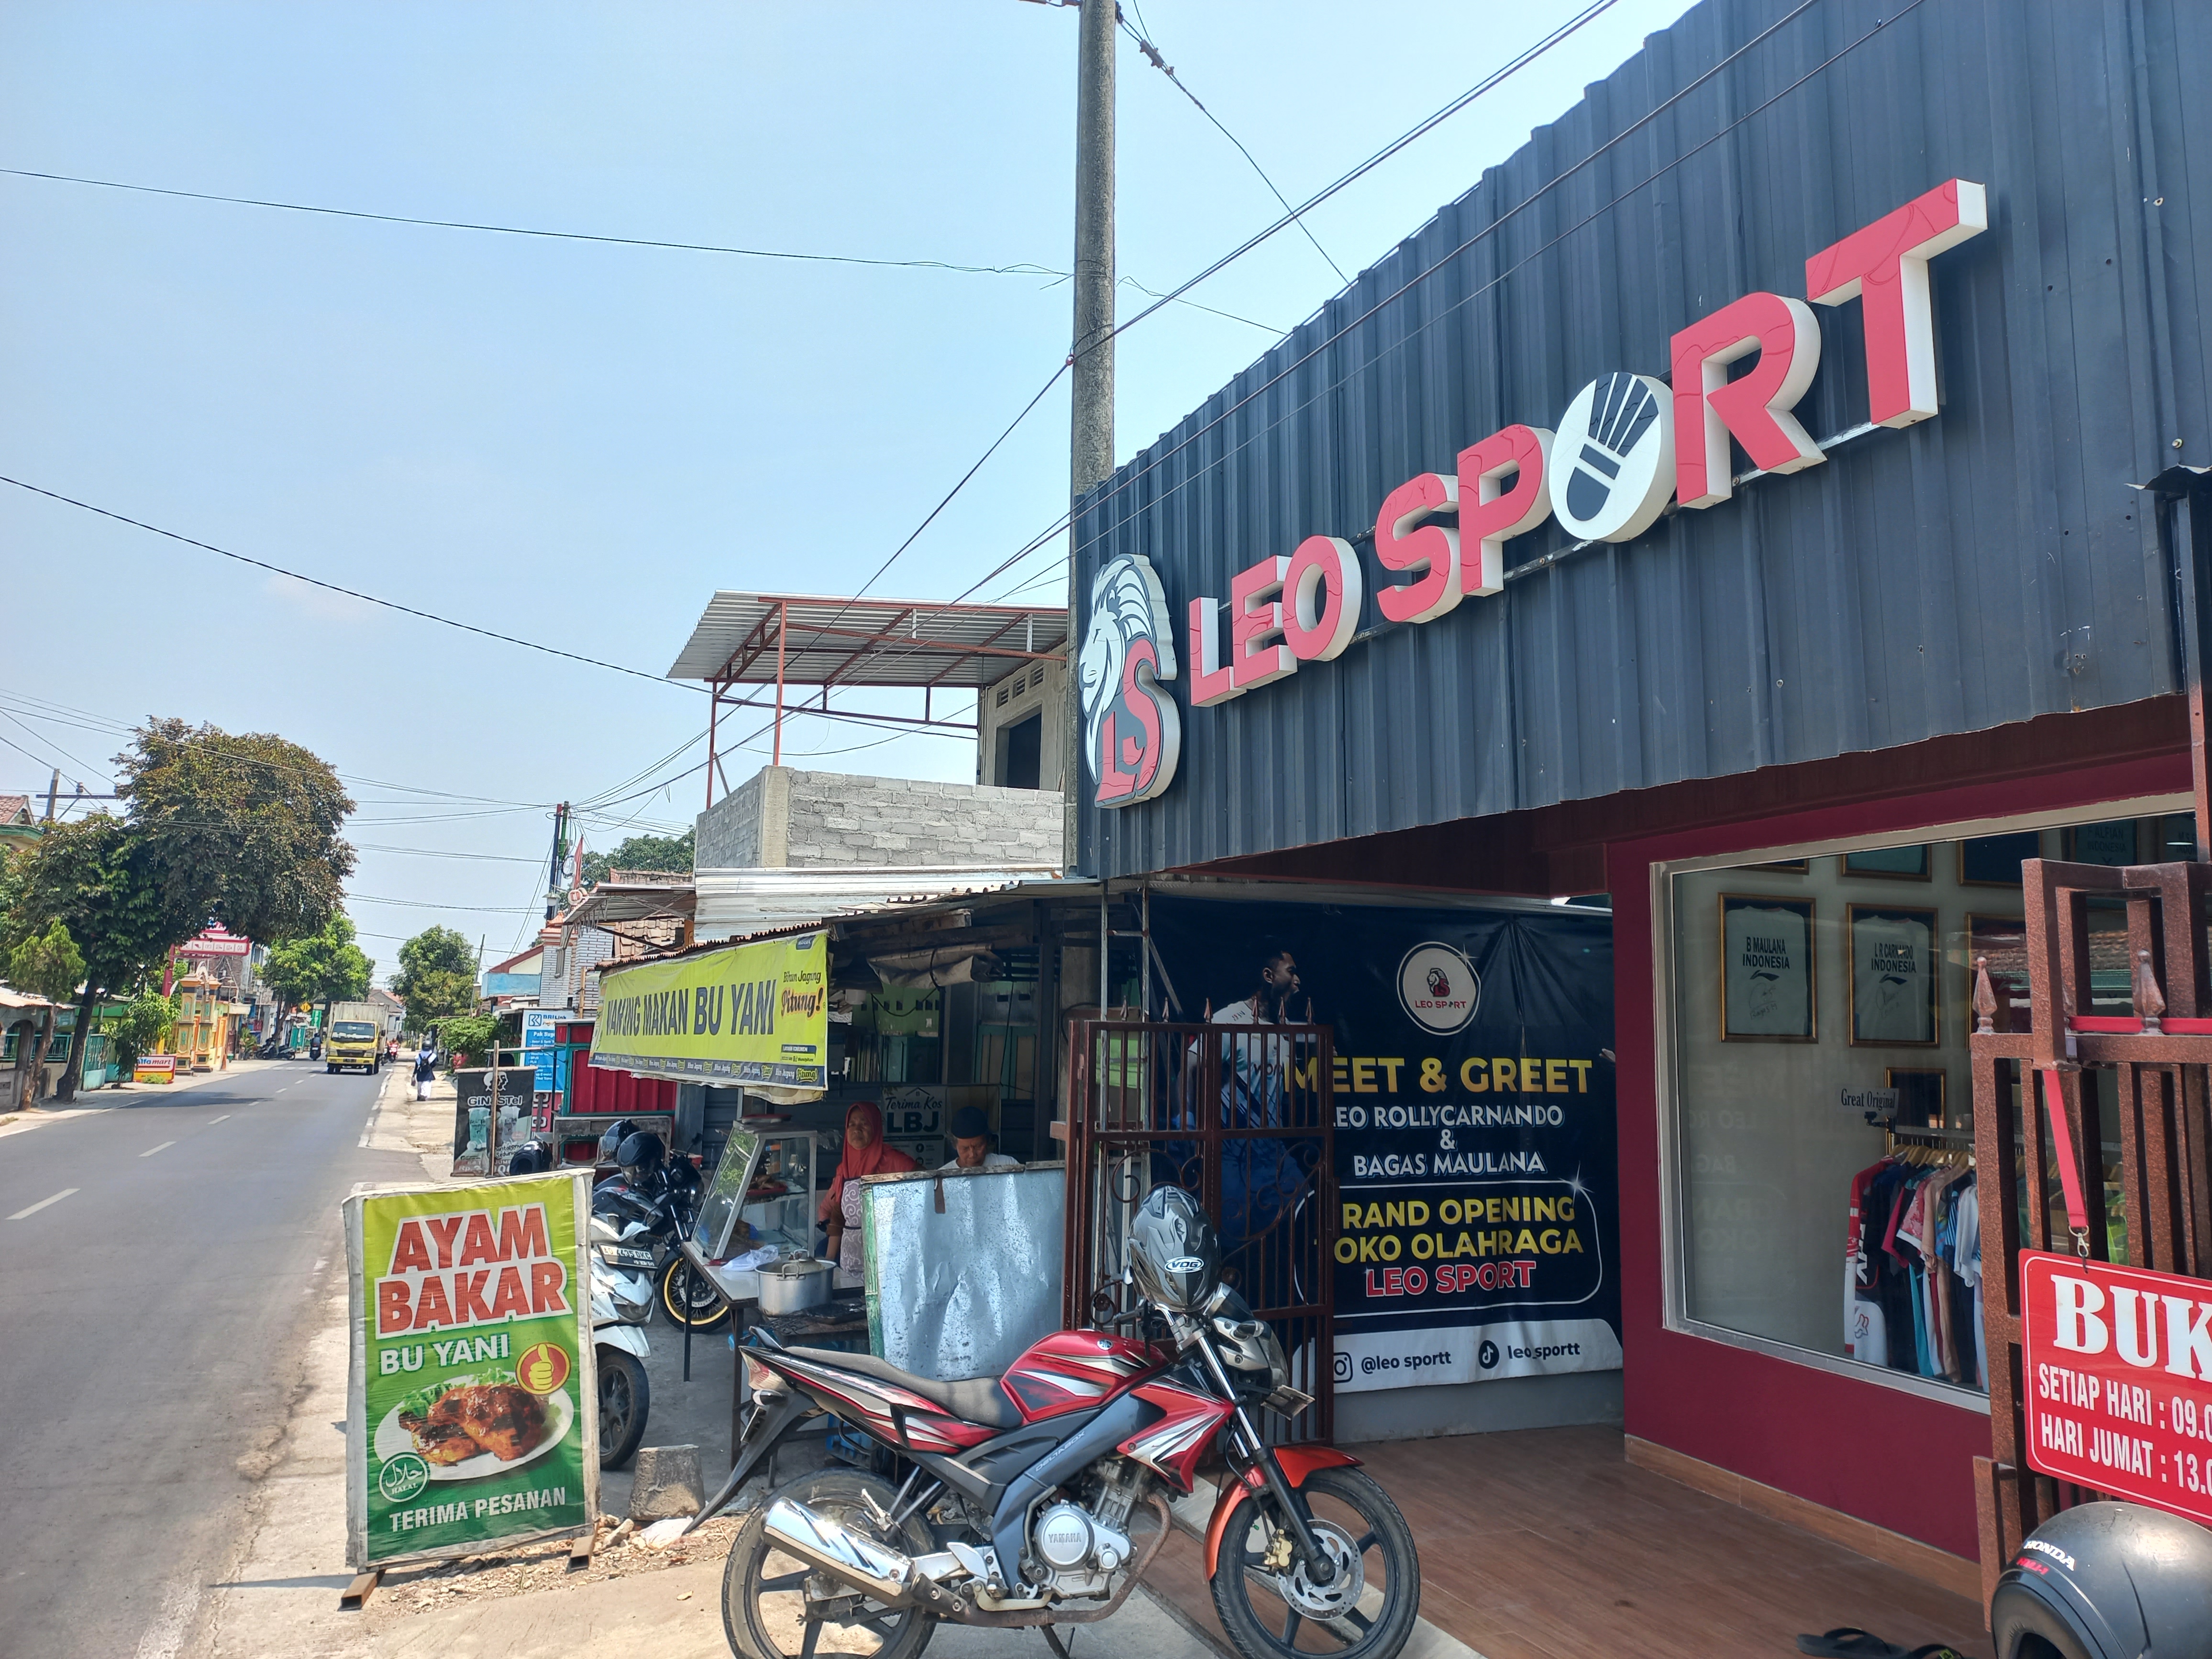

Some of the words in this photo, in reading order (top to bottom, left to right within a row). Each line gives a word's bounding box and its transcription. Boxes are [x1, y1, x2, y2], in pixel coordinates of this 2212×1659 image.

[1189, 535, 1360, 707] LEO
[1375, 178, 1988, 623] SPORT
[1746, 937, 1751, 952] B
[1753, 937, 1786, 954] MAULANA
[1879, 942, 1883, 958] R
[1742, 953, 1790, 969] INDONESIA
[1871, 958, 1917, 973] INDONESIA
[797, 970, 821, 984] Jagung
[693, 984, 724, 1035] BU
[730, 979, 777, 1035] YANI
[781, 987, 824, 1018] Pitung!
[1415, 1000, 1433, 1008] LEO
[1419, 1057, 1448, 1094] &
[1460, 1057, 1593, 1094] GREET
[885, 1096, 921, 1110] Terima
[923, 1096, 942, 1110] Kos
[1841, 1088, 1865, 1107] Great
[1867, 1091, 1896, 1111] Original
[886, 1111, 939, 1133] LBJ
[1333, 1106, 1368, 1128] EO
[1374, 1105, 1564, 1128] ROLLYCARNANDO
[1439, 1128, 1456, 1150] &
[1353, 1154, 1427, 1177] BAGAS
[1433, 1152, 1546, 1175] MAULANA
[1342, 1200, 1430, 1229] RAND
[1438, 1196, 1575, 1226] OPENING
[391, 1207, 548, 1275] AYAM
[1334, 1235, 1403, 1264] OKO
[1411, 1228, 1584, 1260] OLAHRAGA
[1366, 1266, 1429, 1298] LEO
[1435, 1260, 1536, 1294] SPORT
[379, 1261, 566, 1334] BAKAR
[2050, 1274, 2212, 1383] BUK
[380, 1344, 424, 1376] BU
[433, 1333, 509, 1367] YANI
[1361, 1355, 1400, 1374] @leo
[1404, 1351, 1452, 1370] sportt
[2038, 1362, 2101, 1411] SETIAP
[2106, 1379, 2153, 1426] HARI
[1035, 1430, 1085, 1472] DELTABOX
[2040, 1412, 2084, 1458] HARI
[2089, 1427, 2153, 1478] JUMAT
[386, 1462, 423, 1487] حلال
[391, 1482, 418, 1494] HALAL
[389, 1501, 468, 1532] TERIMA
[475, 1486, 566, 1518] PESANAN
[1048, 1532, 1082, 1543] YAMAHA
[2023, 1540, 2075, 1571] HONDA
